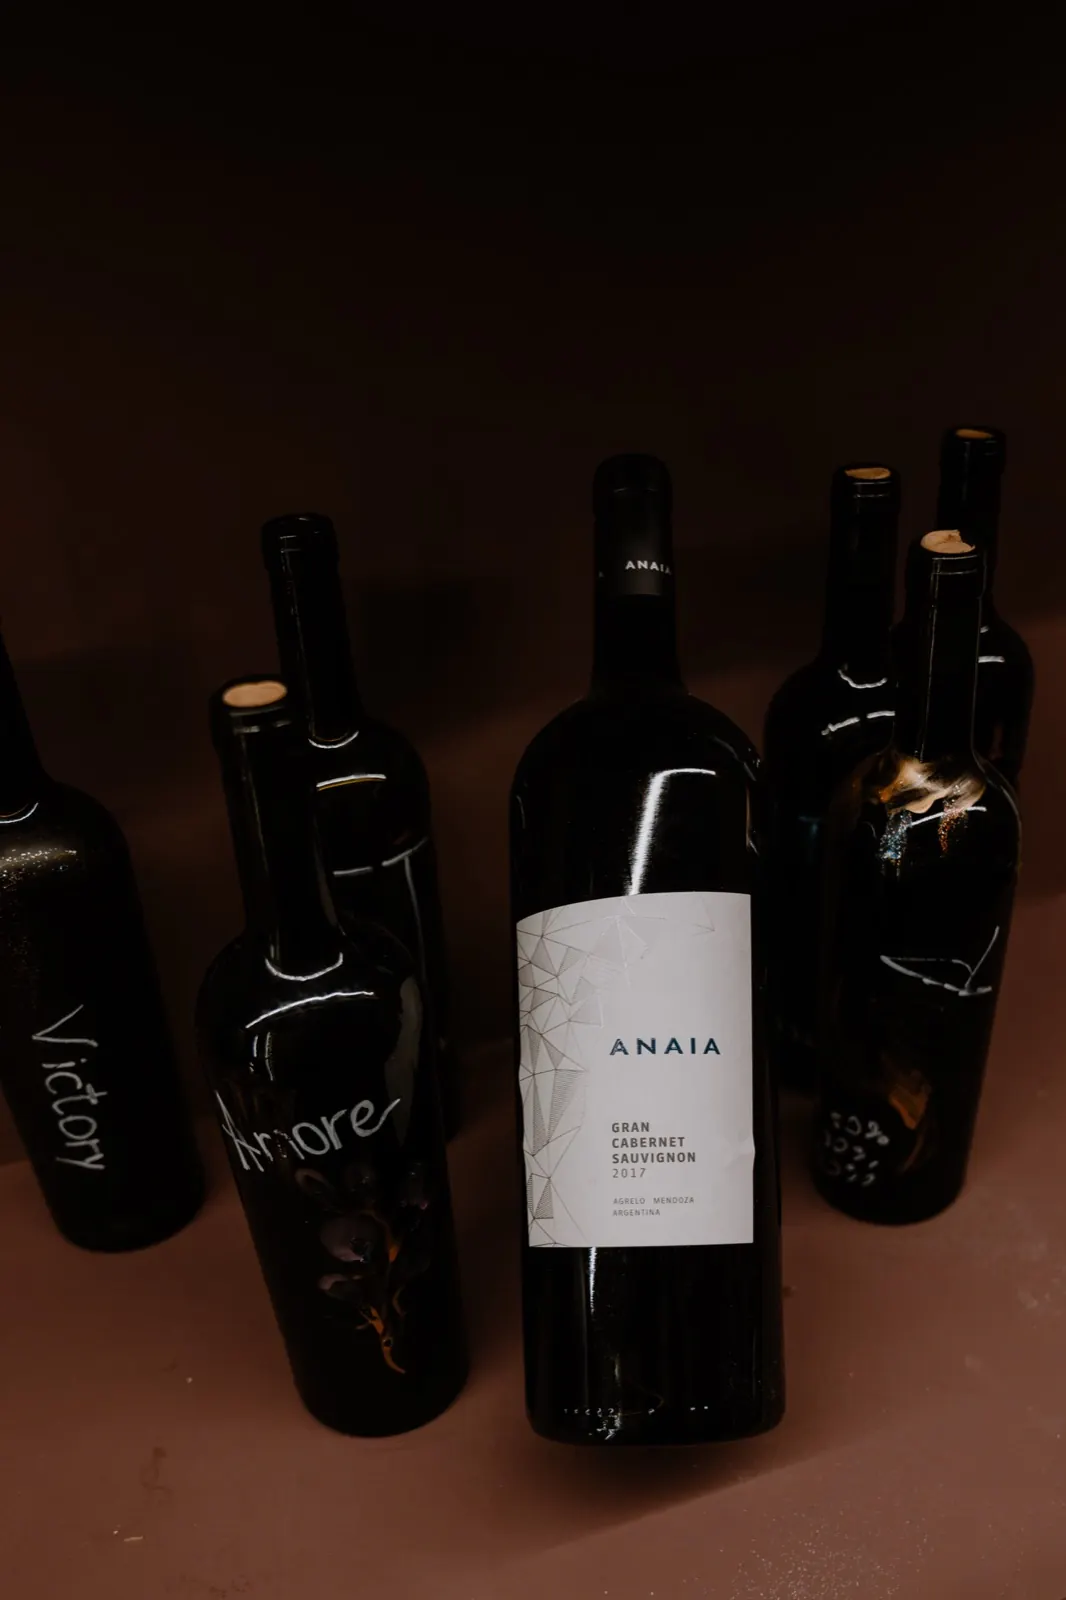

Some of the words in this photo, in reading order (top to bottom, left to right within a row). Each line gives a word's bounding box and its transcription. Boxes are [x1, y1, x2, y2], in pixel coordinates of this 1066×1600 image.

[624, 560, 672, 576] ANAIA
[610, 1038, 720, 1056] ANAIA
[31, 1003, 109, 1171] Victory
[213, 1089, 401, 1172] Amore
[611, 1122, 650, 1133] GRAN
[611, 1136, 685, 1148] CABERNET
[611, 1152, 696, 1164] SAUVIGNON
[612, 1168, 646, 1179] 2017
[612, 1197, 646, 1206] AGRELO
[653, 1195, 695, 1205] MENDOZA
[612, 1208, 661, 1217] ARGENTINA
